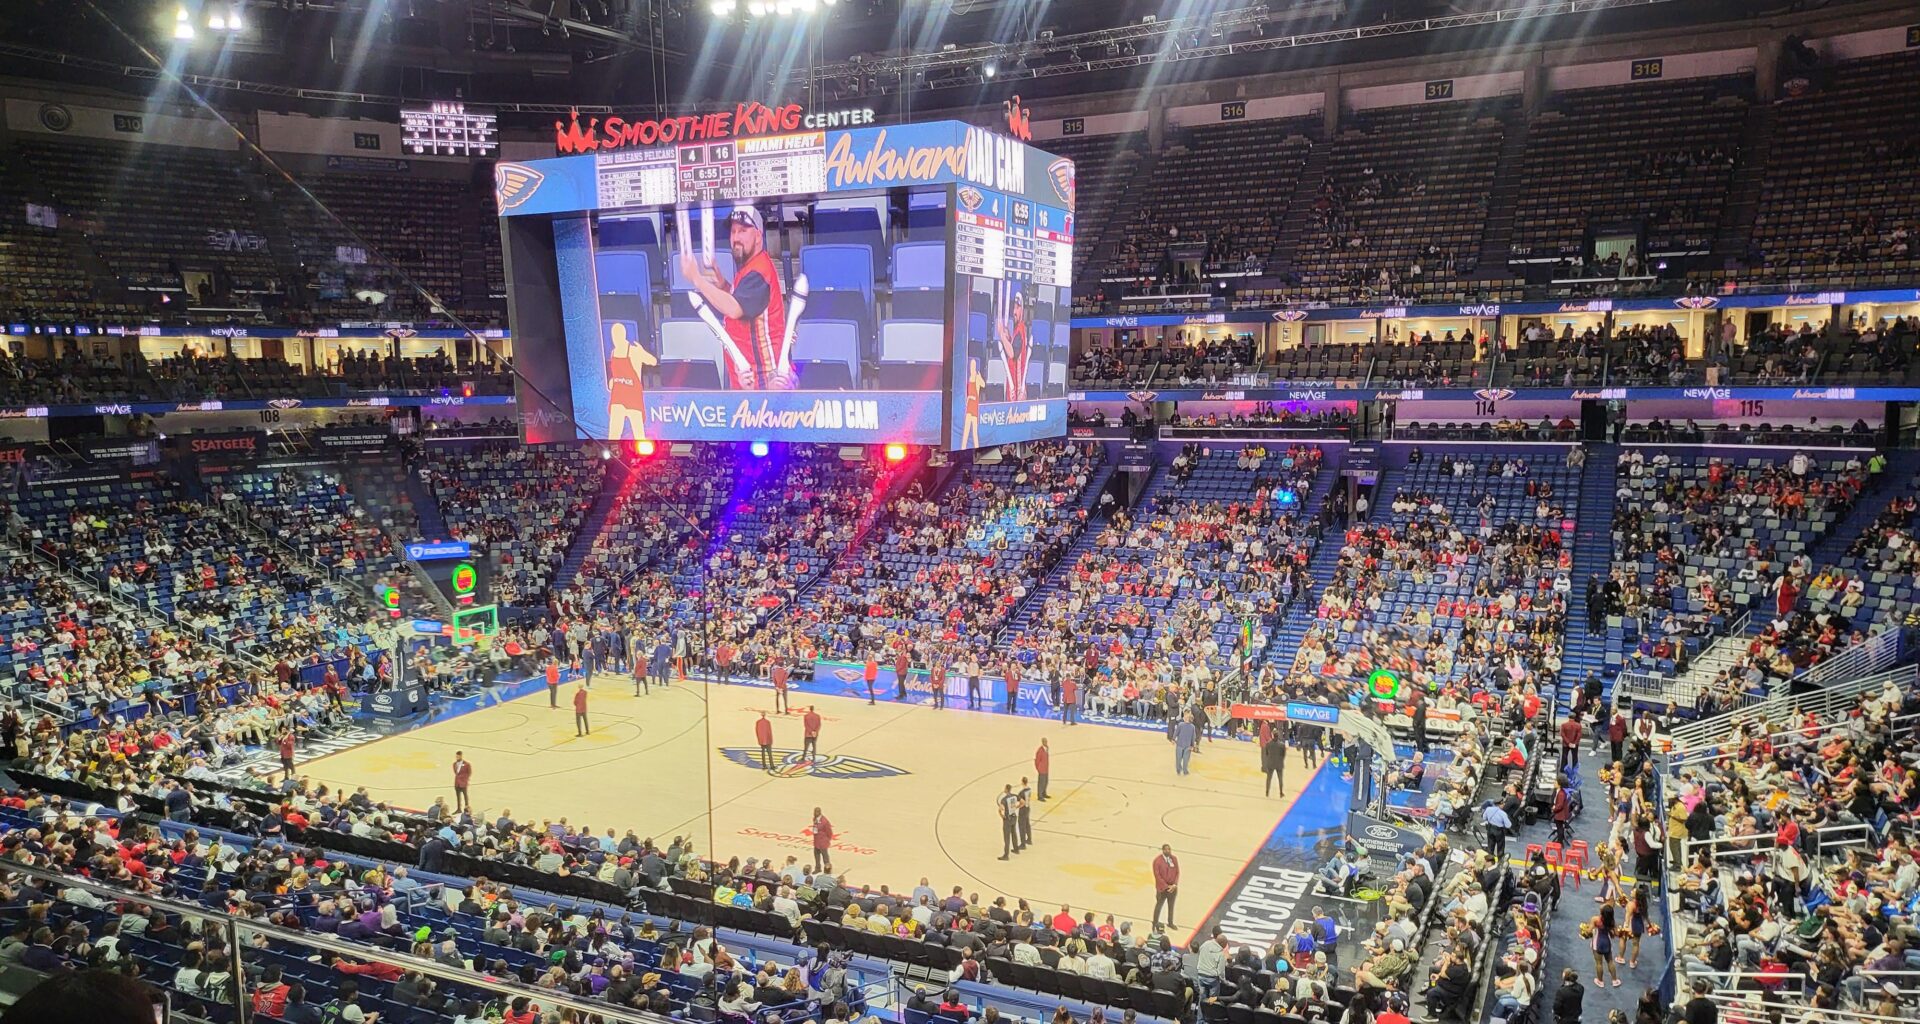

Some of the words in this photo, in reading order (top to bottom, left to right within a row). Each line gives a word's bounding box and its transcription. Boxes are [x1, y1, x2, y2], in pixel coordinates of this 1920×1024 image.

[1634, 62, 1660, 75] 318
[1428, 84, 1450, 97] 317
[432, 103, 464, 114] HEAT
[1223, 105, 1243, 117] 316
[602, 112, 733, 149] SMOOTHIE
[804, 109, 875, 128] CENTER
[1064, 121, 1082, 132] 315
[359, 136, 377, 147] 311
[745, 140, 783, 153] MIAMI
[785, 135, 817, 148] HEAT
[645, 149, 675, 161] PELICANS
[688, 150, 696, 161] 4
[715, 147, 728, 158] 16
[827, 127, 972, 187] Awkward
[968, 128, 994, 186] DAD
[997, 137, 1024, 194] CAM
[698, 168, 717, 179] 6:55
[992, 198, 999, 217] 4
[1014, 202, 1029, 219] 6:55
[1040, 210, 1048, 227] 16
[1517, 247, 1531, 255] 317
[1459, 304, 1499, 316] NEWAGE
[1106, 317, 1138, 327] NEWAGE
[35, 326, 40, 334] 6
[66, 326, 71, 334] 6
[98, 326, 103, 334] 0
[211, 328, 247, 337] NEWAGE
[1289, 390, 1326, 400] NEWAGE
[1683, 387, 1730, 399] NEWAGE
[431, 397, 464, 406] NEWAGE
[95, 404, 131, 415] NEWAGE
[650, 400, 727, 427] NEWAGE
[731, 399, 819, 429] Awkward
[816, 400, 842, 428] DAD
[845, 400, 879, 429] CAM
[1475, 401, 1495, 415] 114
[1740, 400, 1763, 416] 115
[259, 410, 280, 423] 108
[980, 409, 1005, 426] NEWAGE
[191, 437, 256, 452] SEATGEEK
[947, 676, 967, 697] DAD
[1293, 706, 1331, 720] NEWAGE
[1369, 826, 1394, 838] Ford
[1359, 837, 1384, 846] SOUTHERN
[1384, 841, 1404, 849] QUALITY
